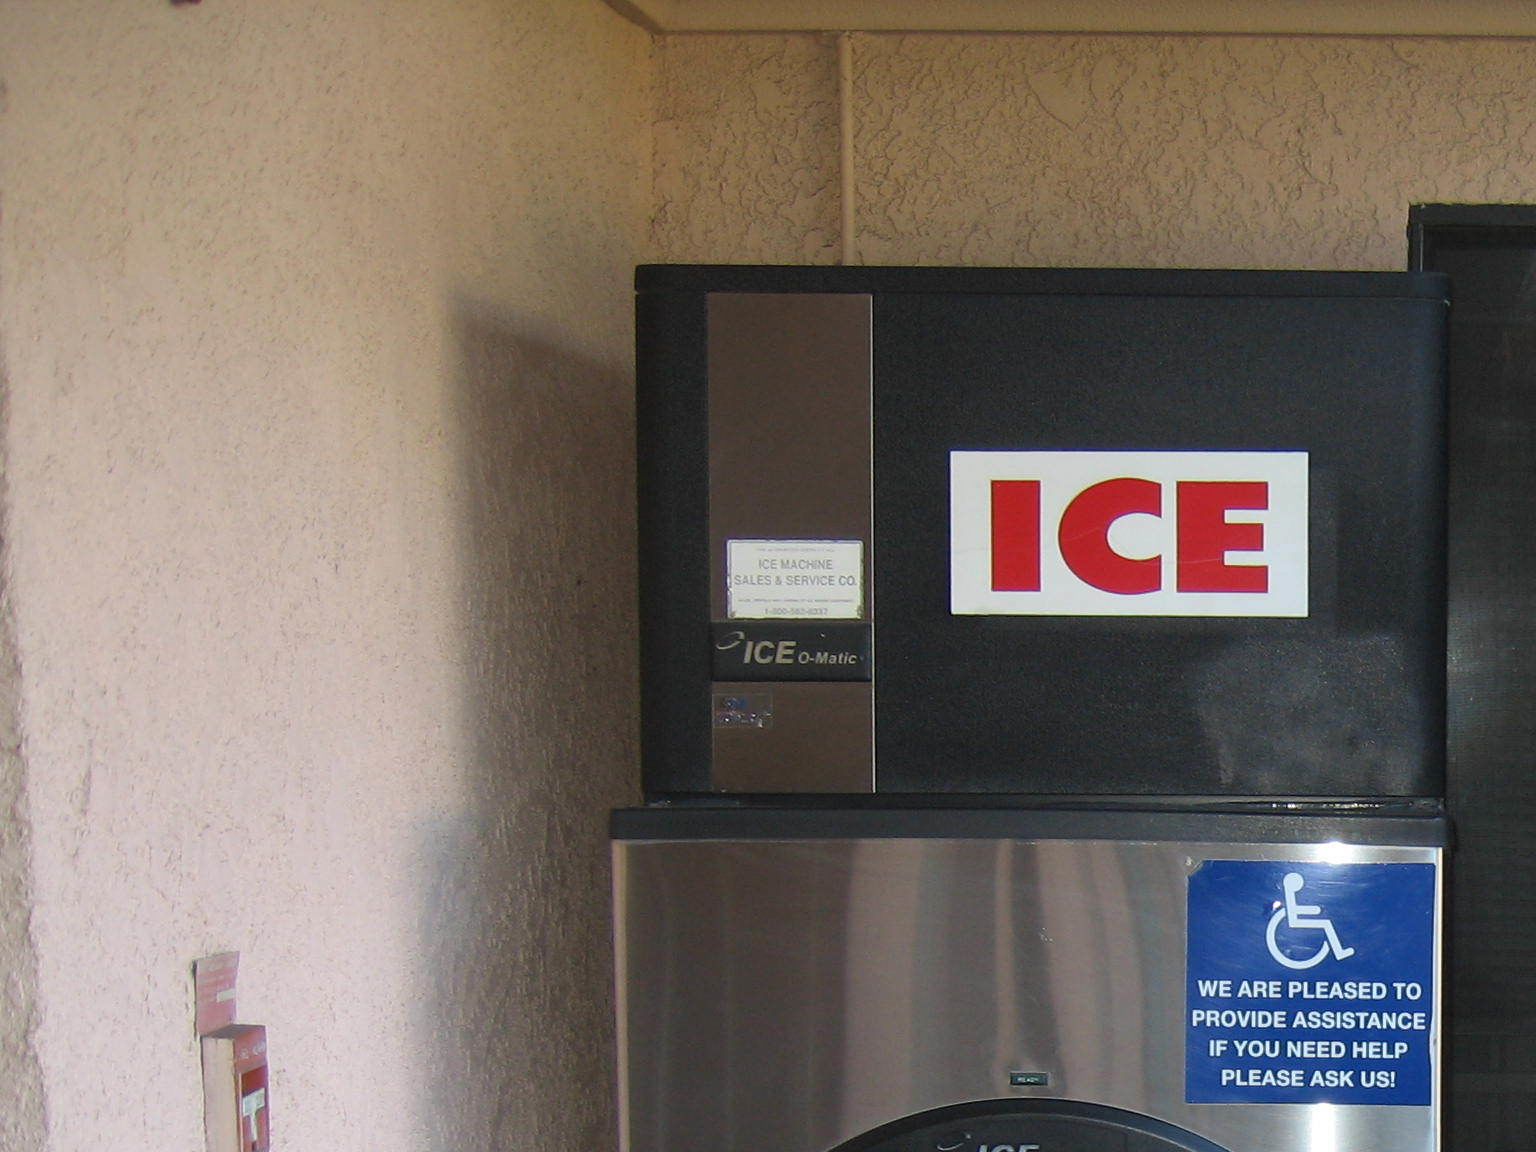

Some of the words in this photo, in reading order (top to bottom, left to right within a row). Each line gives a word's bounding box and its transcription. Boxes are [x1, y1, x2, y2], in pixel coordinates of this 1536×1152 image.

[990, 477, 1269, 595] ICE
[758, 559, 778, 570] ICE
[781, 559, 833, 570] MACHINE
[734, 575, 772, 586] SALES
[786, 575, 835, 586] SERVICE
[743, 640, 797, 664] ICE
[798, 651, 857, 664] O-Matic
[1198, 980, 1232, 998] WE
[1237, 980, 1283, 998] ARE
[1288, 981, 1388, 1000] PLEASED
[1393, 982, 1423, 1000] TO
[1192, 1010, 1287, 1029] PROVIDE
[1292, 1011, 1427, 1031] ASSISTANCE
[1208, 1039, 1228, 1057] IF
[1233, 1040, 1281, 1058] YOU
[1287, 1040, 1346, 1058] NEED
[1352, 1041, 1409, 1059] HELP
[1221, 1069, 1304, 1087] PLEASE
[1309, 1070, 1355, 1088] ASK
[1360, 1070, 1397, 1088] US!
